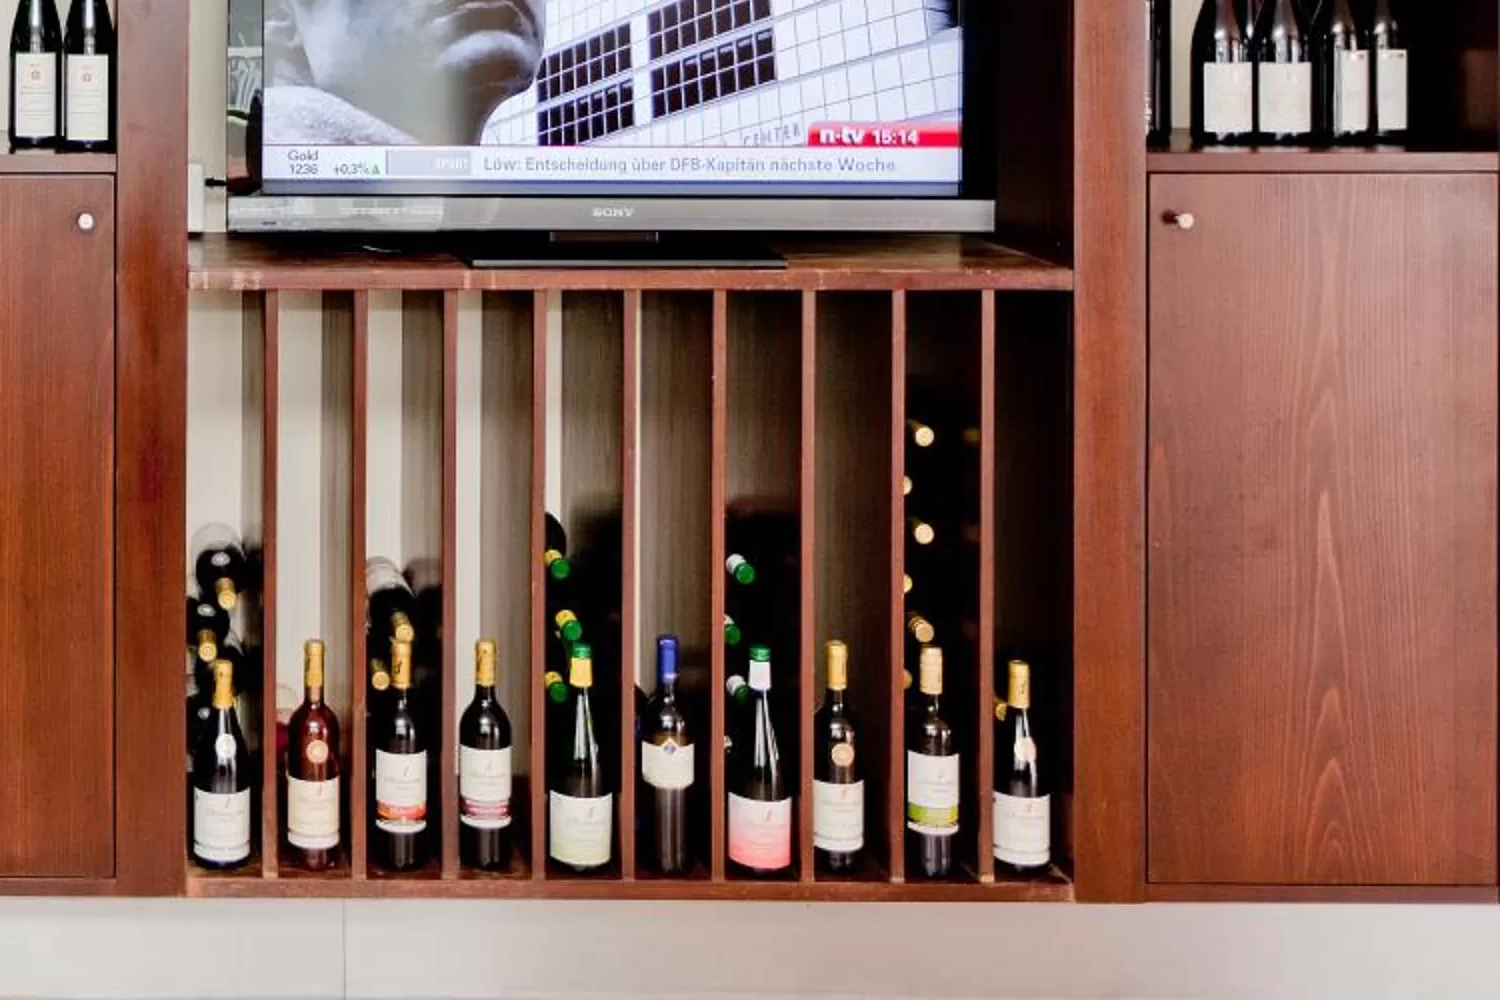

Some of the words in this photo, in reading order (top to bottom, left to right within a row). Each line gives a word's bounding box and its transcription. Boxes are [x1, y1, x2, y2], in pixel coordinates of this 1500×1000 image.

[287, 149, 319, 162] Gold
[526, 156, 627, 173] Entscheidung
[632, 156, 666, 171] über
[670, 157, 765, 174] DFB-Kapitän
[770, 157, 832, 172] nächste
[838, 157, 896, 172] Woche
[592, 207, 634, 217] SONY
